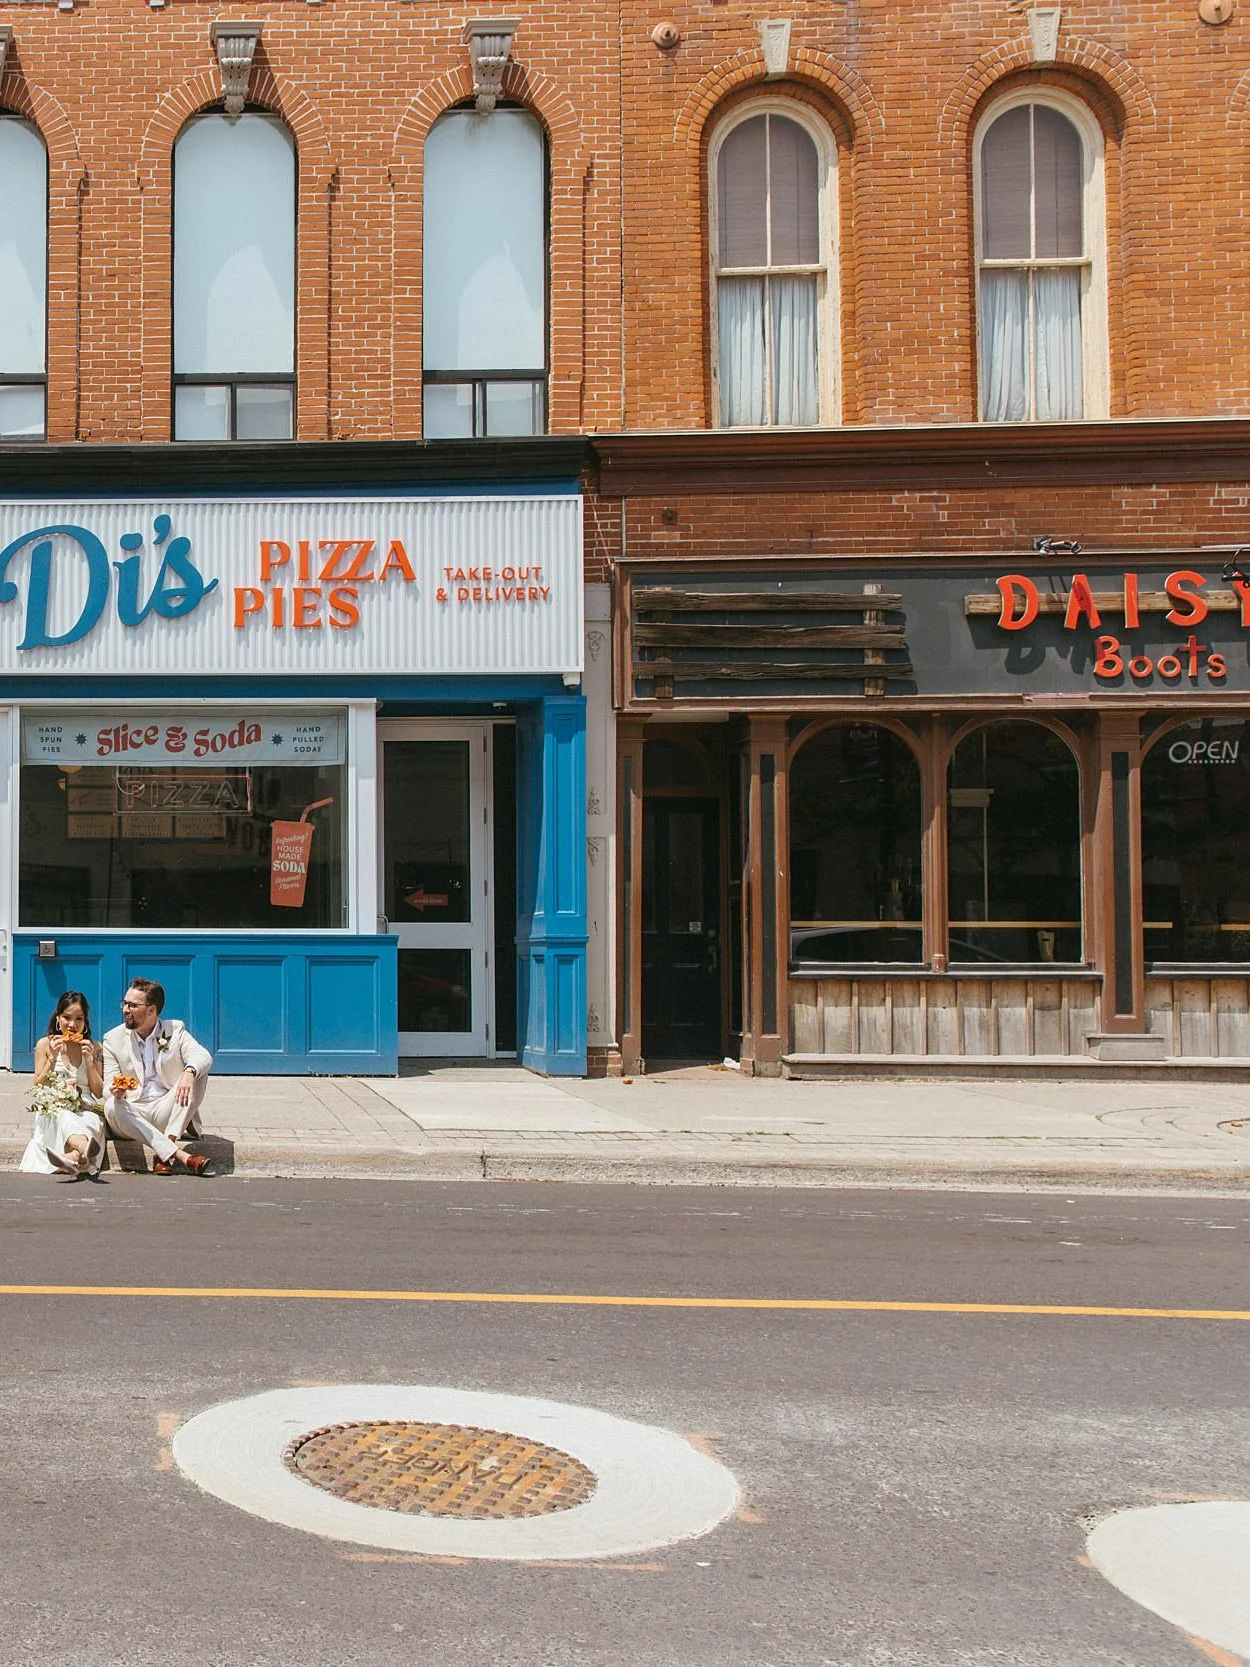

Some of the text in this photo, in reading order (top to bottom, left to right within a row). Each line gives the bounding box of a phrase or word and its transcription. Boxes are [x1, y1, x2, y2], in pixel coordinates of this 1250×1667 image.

[259, 540, 417, 581] PIZZA
[443, 566, 542, 582] TAKE-OUT
[234, 586, 360, 628] PIES
[436, 587, 551, 601] & DELIVERY
[1093, 635, 1228, 678] Boots
[96, 719, 262, 757] Slice & Soda
[1169, 740, 1239, 763] OPEN
[124, 780, 240, 808] PIZZA
[272, 860, 306, 873] SODA
